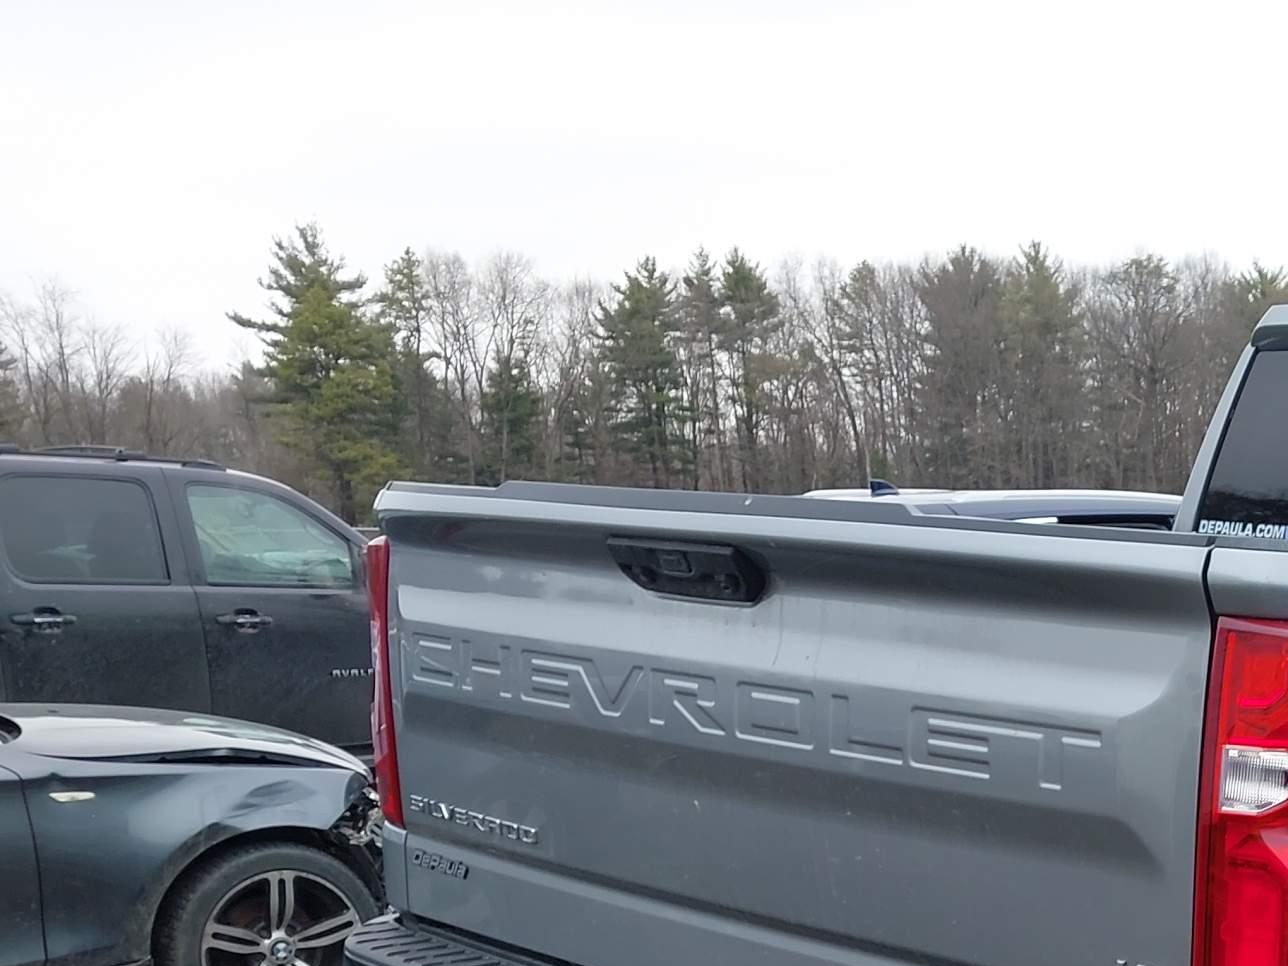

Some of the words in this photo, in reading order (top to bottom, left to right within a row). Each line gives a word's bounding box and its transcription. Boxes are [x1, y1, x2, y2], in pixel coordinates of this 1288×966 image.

[1198, 519, 1286, 539] DEPAULA.COM
[412, 632, 1101, 791] CHEVROLET
[409, 794, 538, 844] SILVERADO
